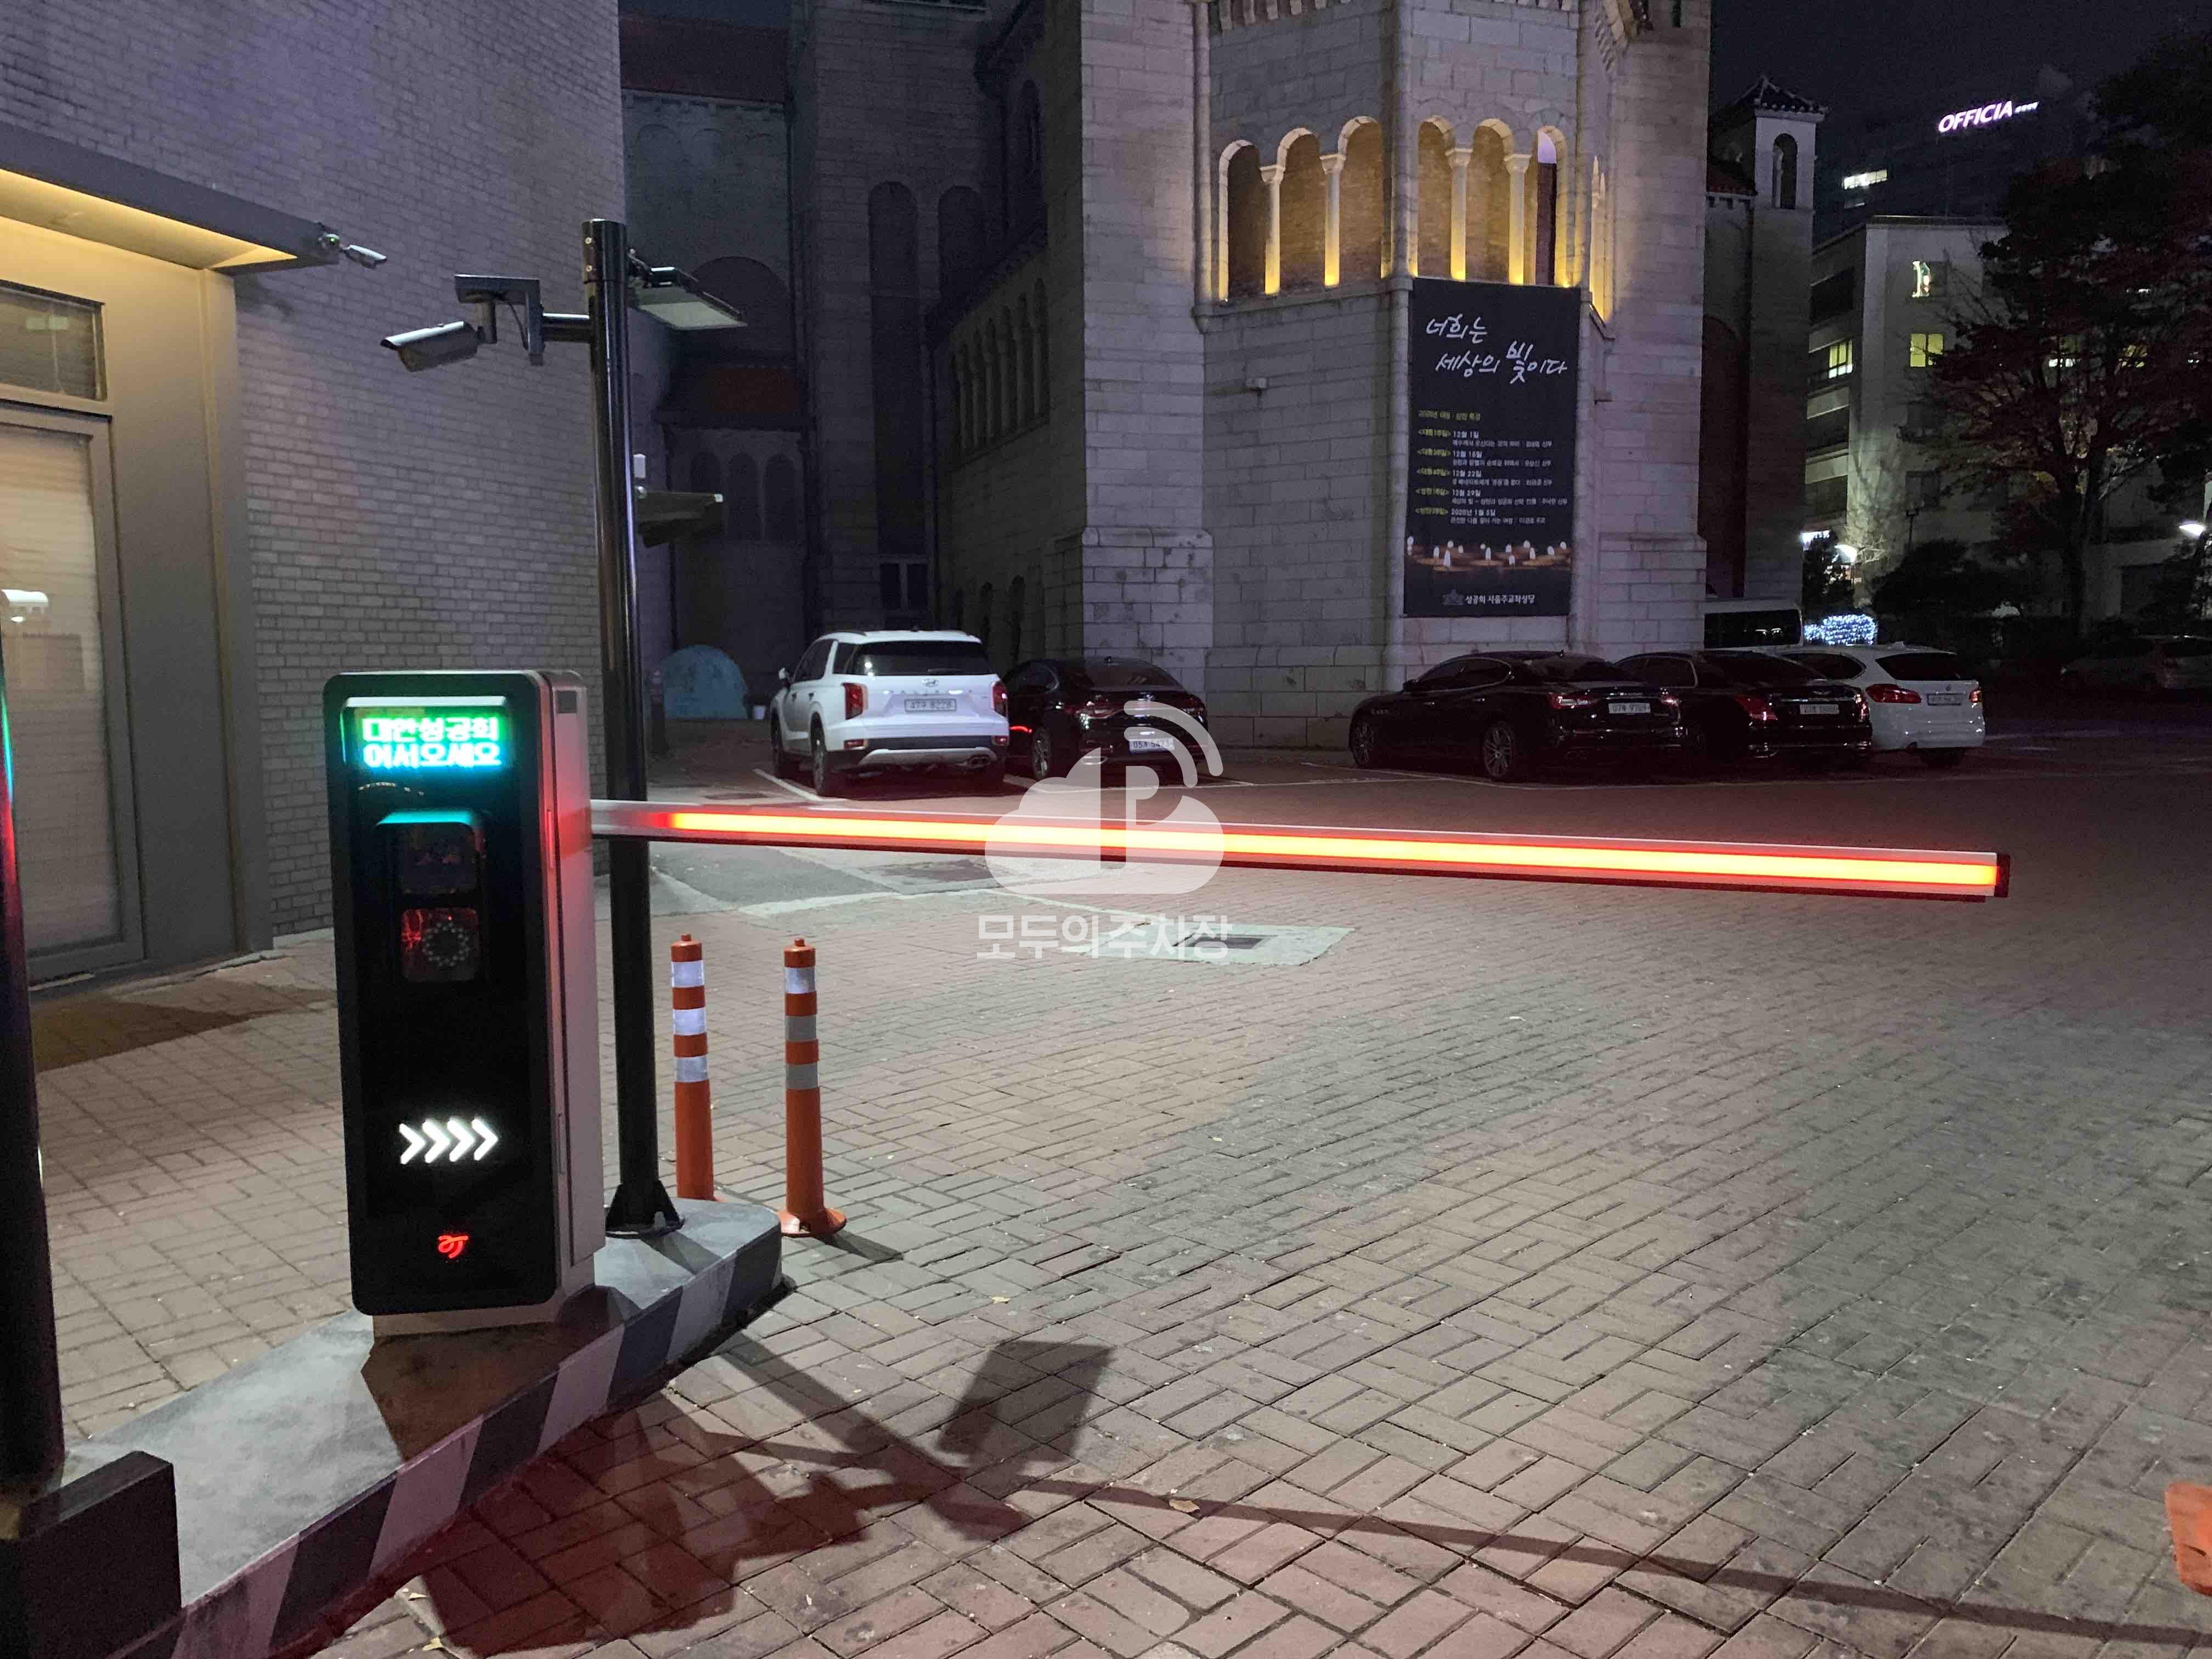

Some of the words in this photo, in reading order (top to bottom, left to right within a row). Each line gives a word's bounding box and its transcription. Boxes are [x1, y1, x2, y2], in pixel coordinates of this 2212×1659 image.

[1938, 101, 2013, 132] OFFICIA
[1426, 313, 1488, 343] 너희는
[1435, 350, 1500, 377] 세상의
[1506, 341, 1567, 384] 빛이다
[363, 718, 498, 742] 대한성공회
[364, 743, 501, 767] 어서오세요
